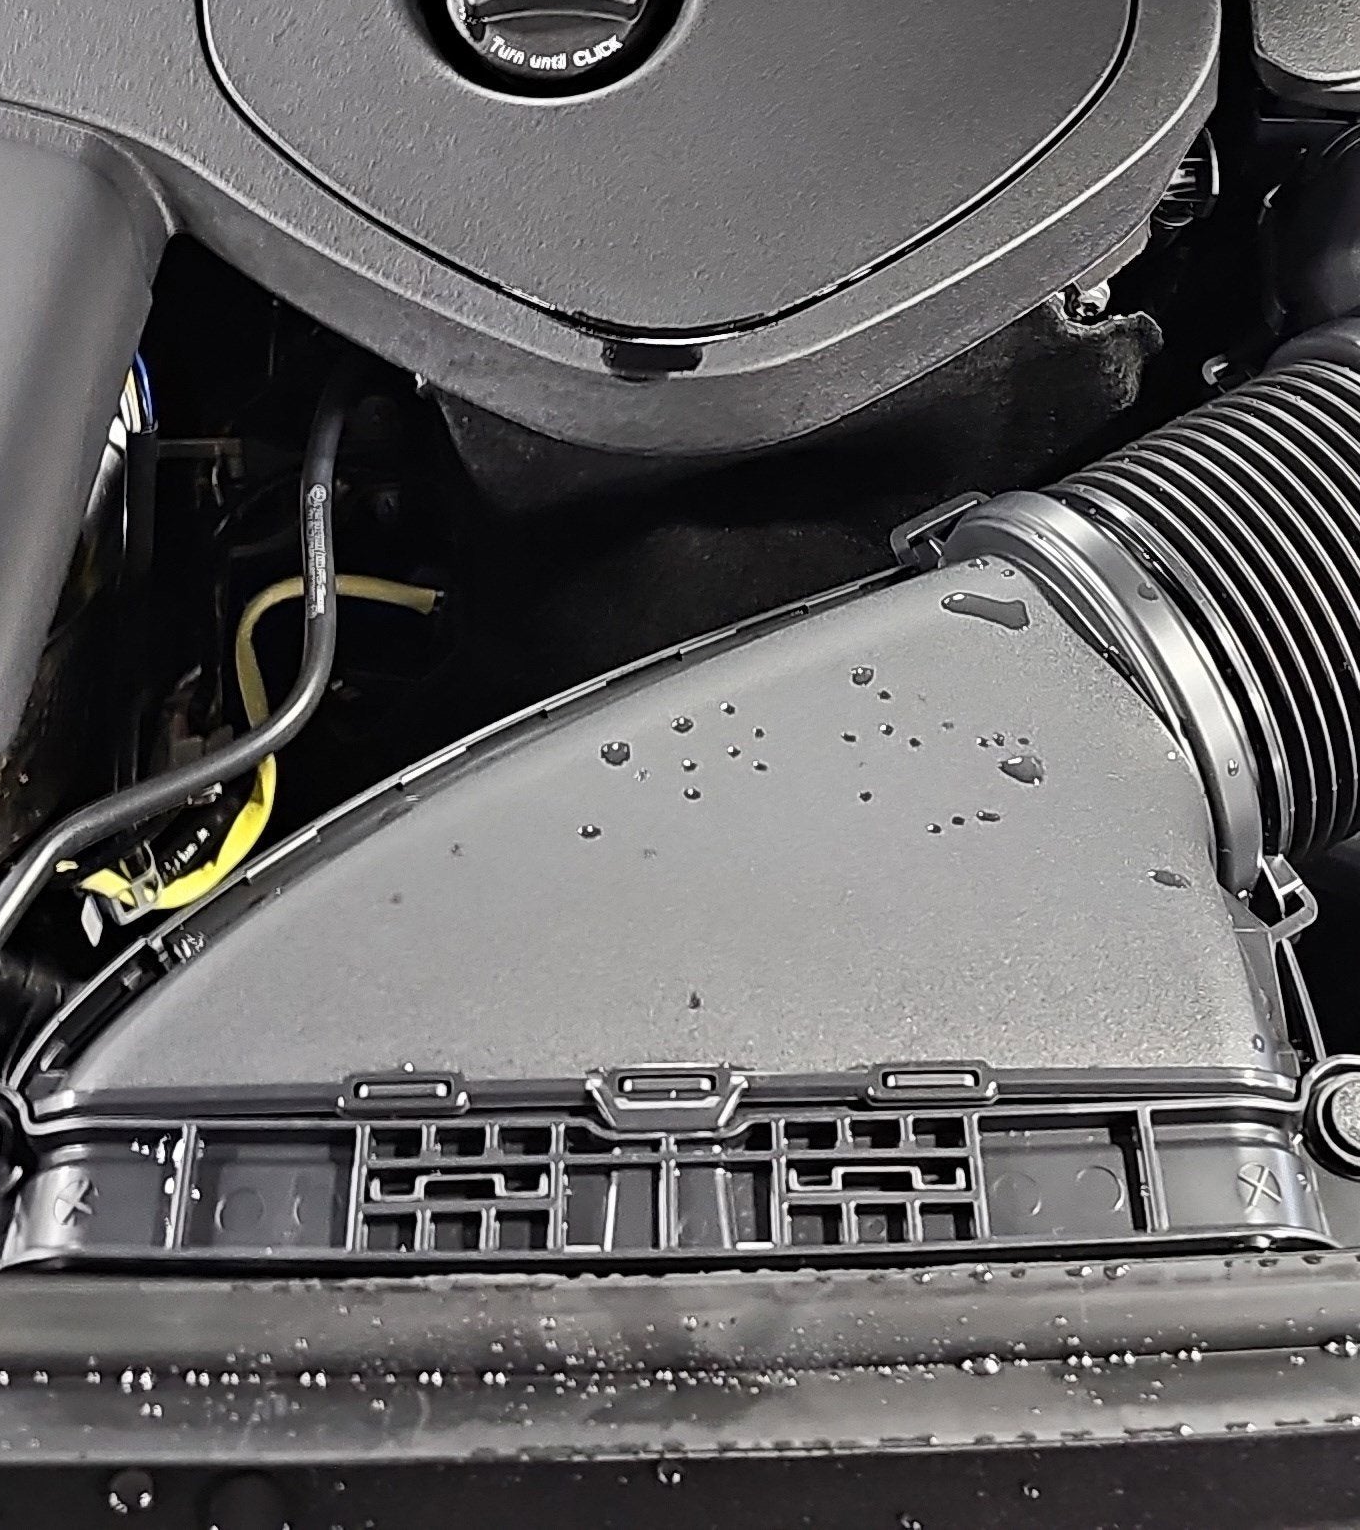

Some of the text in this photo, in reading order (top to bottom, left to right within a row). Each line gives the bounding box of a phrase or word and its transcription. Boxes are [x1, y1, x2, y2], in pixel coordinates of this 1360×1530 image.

[489, 34, 624, 70] Turn until CLICK
